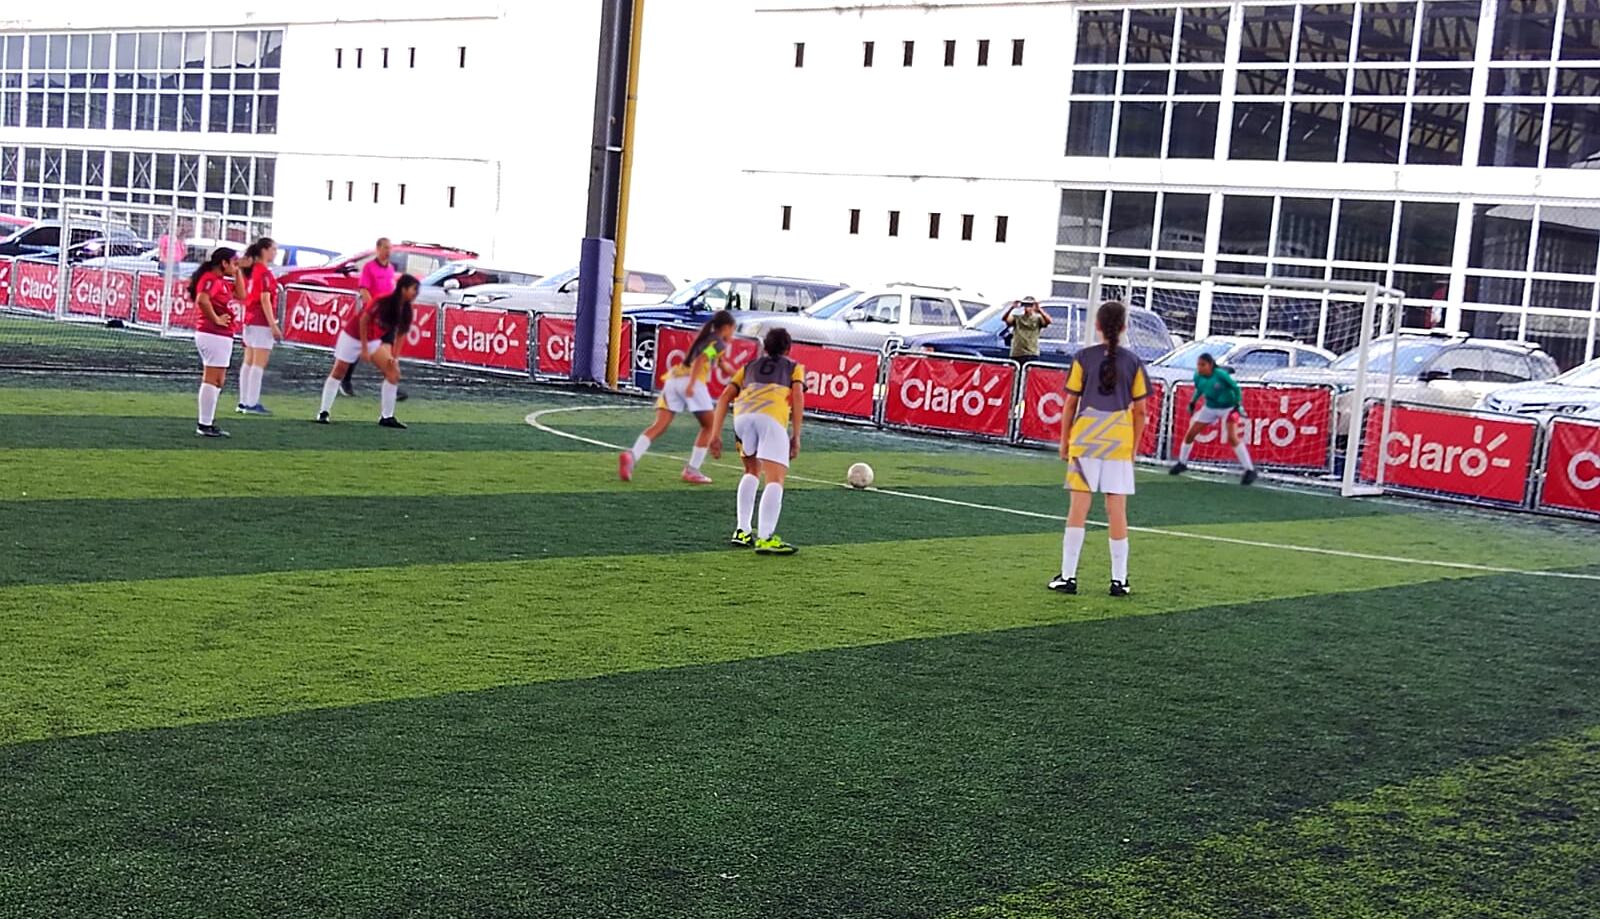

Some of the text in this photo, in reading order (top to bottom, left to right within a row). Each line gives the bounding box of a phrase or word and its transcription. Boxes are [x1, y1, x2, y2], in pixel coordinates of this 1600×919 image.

[76, 281, 117, 306] Clao
[291, 305, 340, 335] Claro
[452, 324, 508, 355] Claro
[805, 370, 849, 399] aro
[900, 378, 985, 416] Claro
[1384, 431, 1488, 477] Claro
